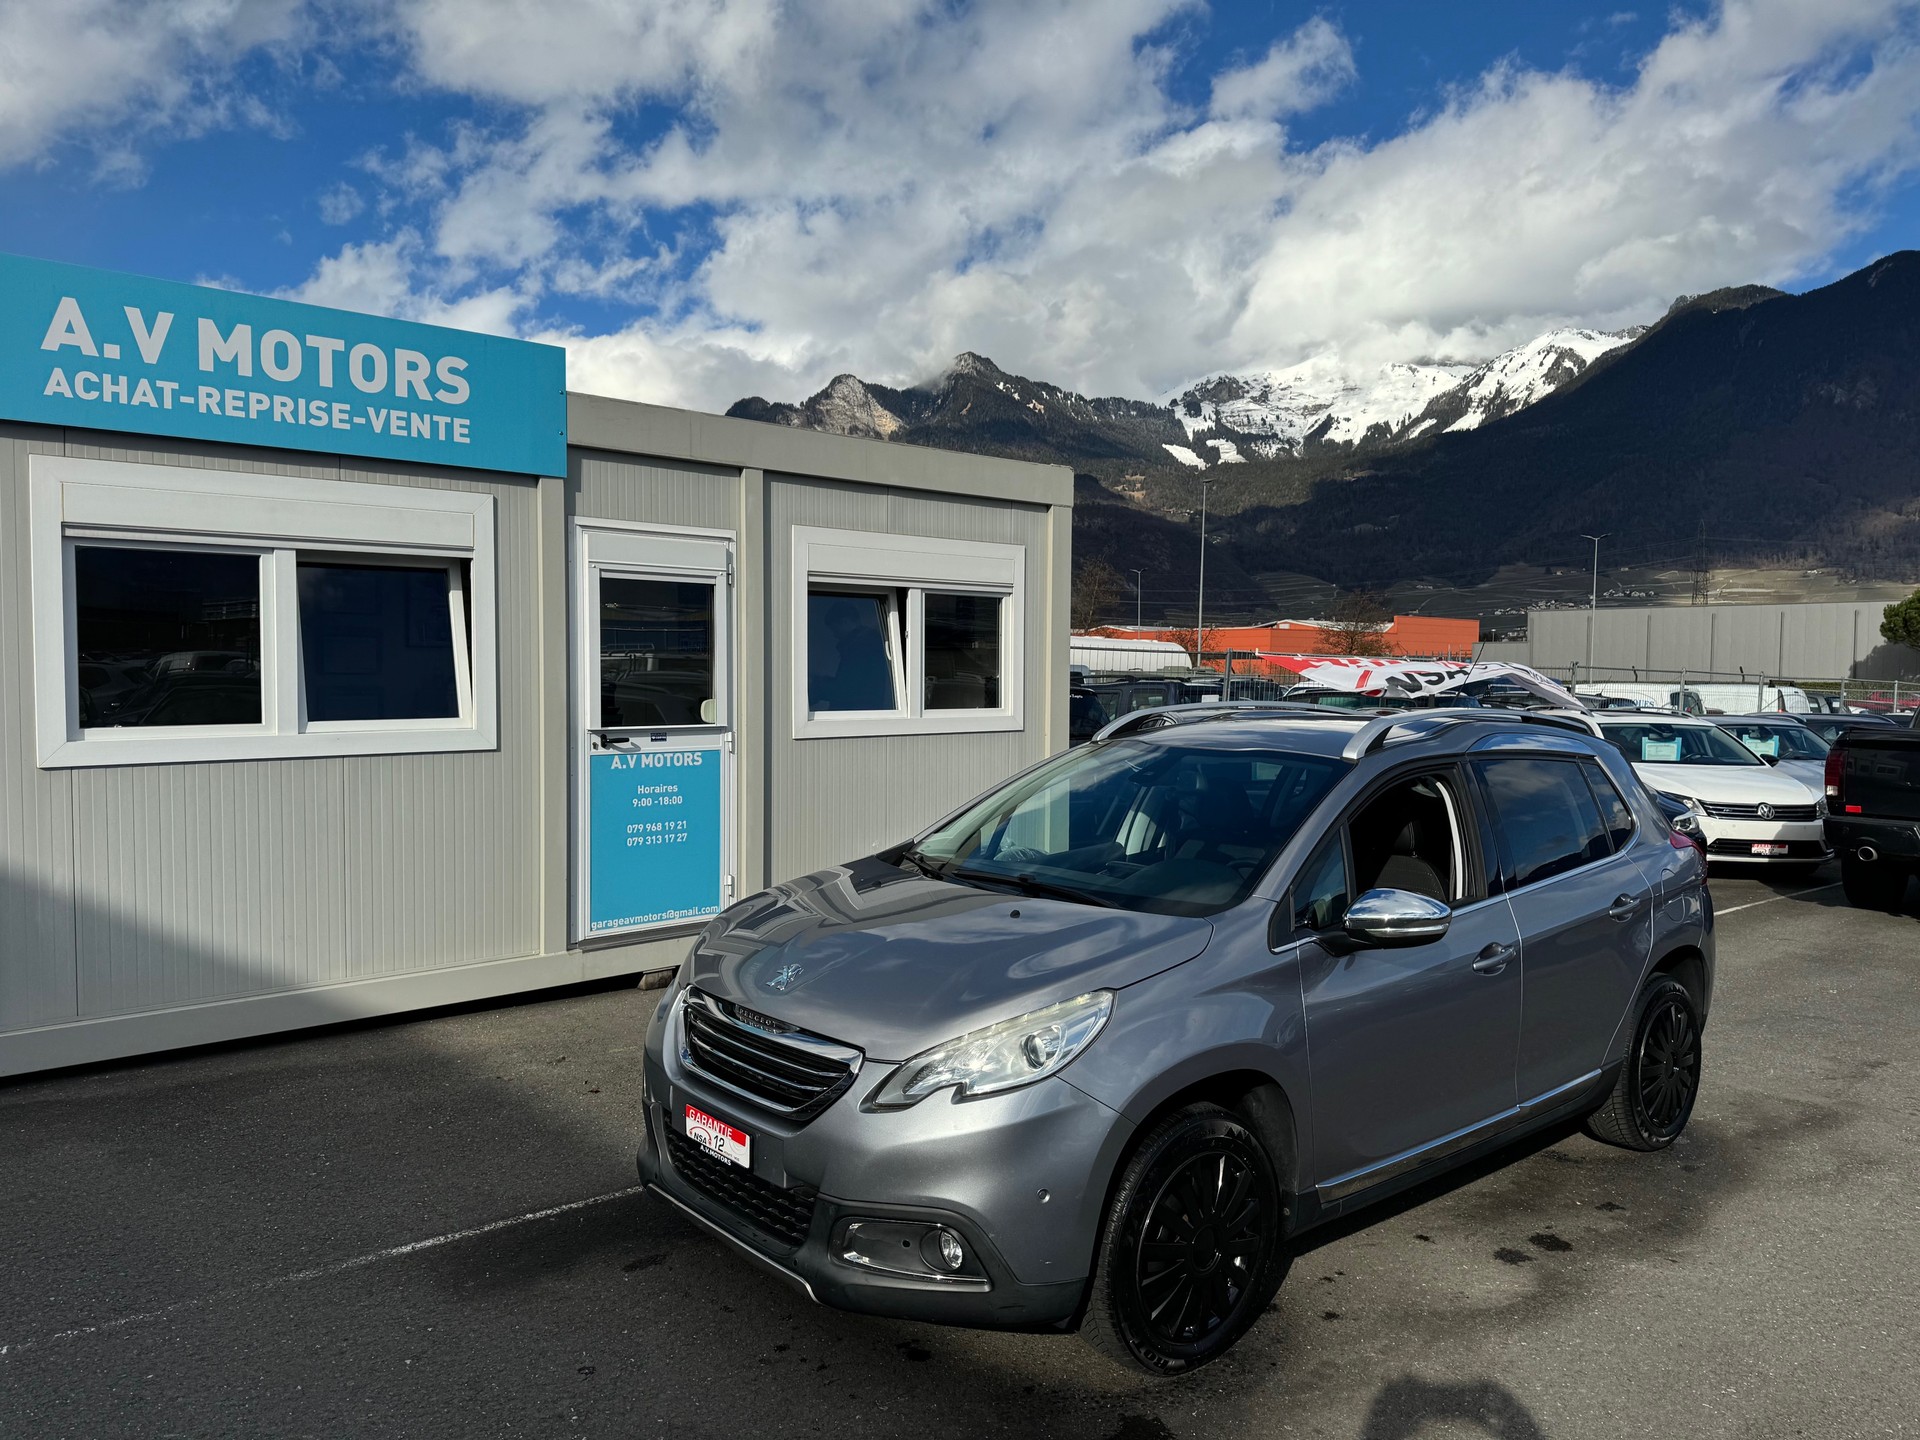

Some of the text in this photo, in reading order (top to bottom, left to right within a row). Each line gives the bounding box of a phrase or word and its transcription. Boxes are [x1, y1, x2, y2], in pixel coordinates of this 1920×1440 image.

[41, 297, 470, 404] A.V MOTORS
[44, 368, 470, 443] ACHAT-REPRISE-VENTE
[611, 752, 702, 769] A.V MOTORS
[638, 784, 678, 794] Horaires
[633, 798, 652, 807] 9:00
[627, 821, 687, 833] 079 968 19 21
[627, 833, 687, 846] 079 313 17 27
[591, 905, 719, 931] garageavmotors@gmail.com
[689, 1109, 733, 1140] GARANTIE
[694, 1132, 725, 1153] NSA 12
